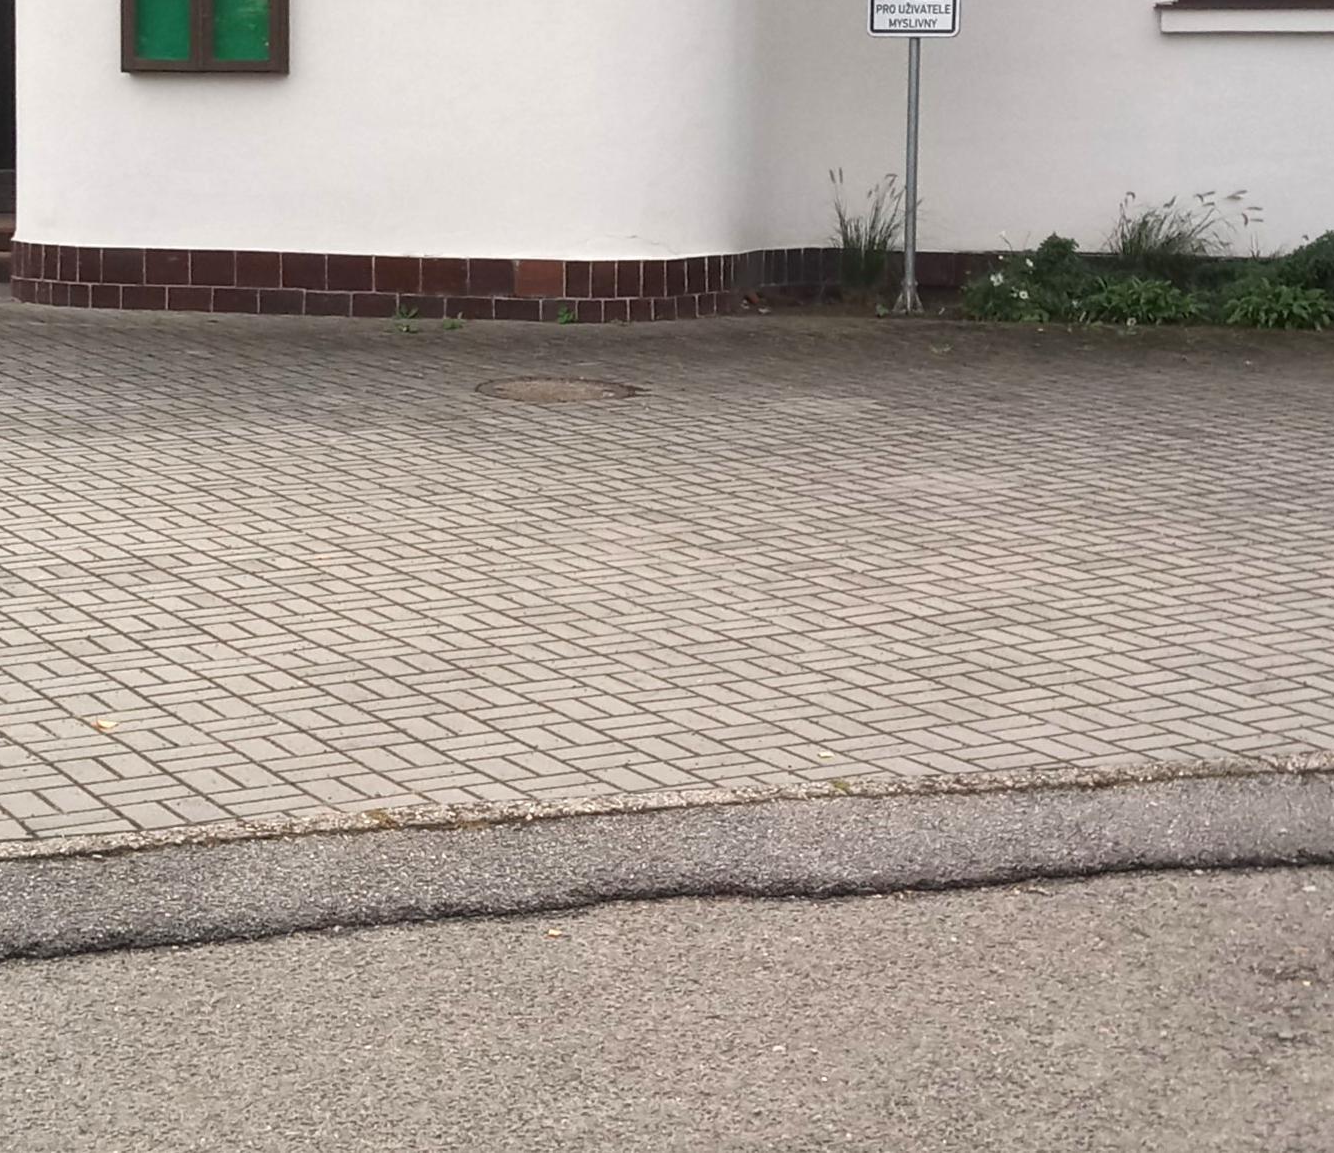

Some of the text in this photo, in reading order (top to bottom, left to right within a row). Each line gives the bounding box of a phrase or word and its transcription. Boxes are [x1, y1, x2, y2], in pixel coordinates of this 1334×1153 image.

[876, 2, 952, 14] PRO UŽIVATELE
[888, 18, 938, 28] MYSLIVNY
